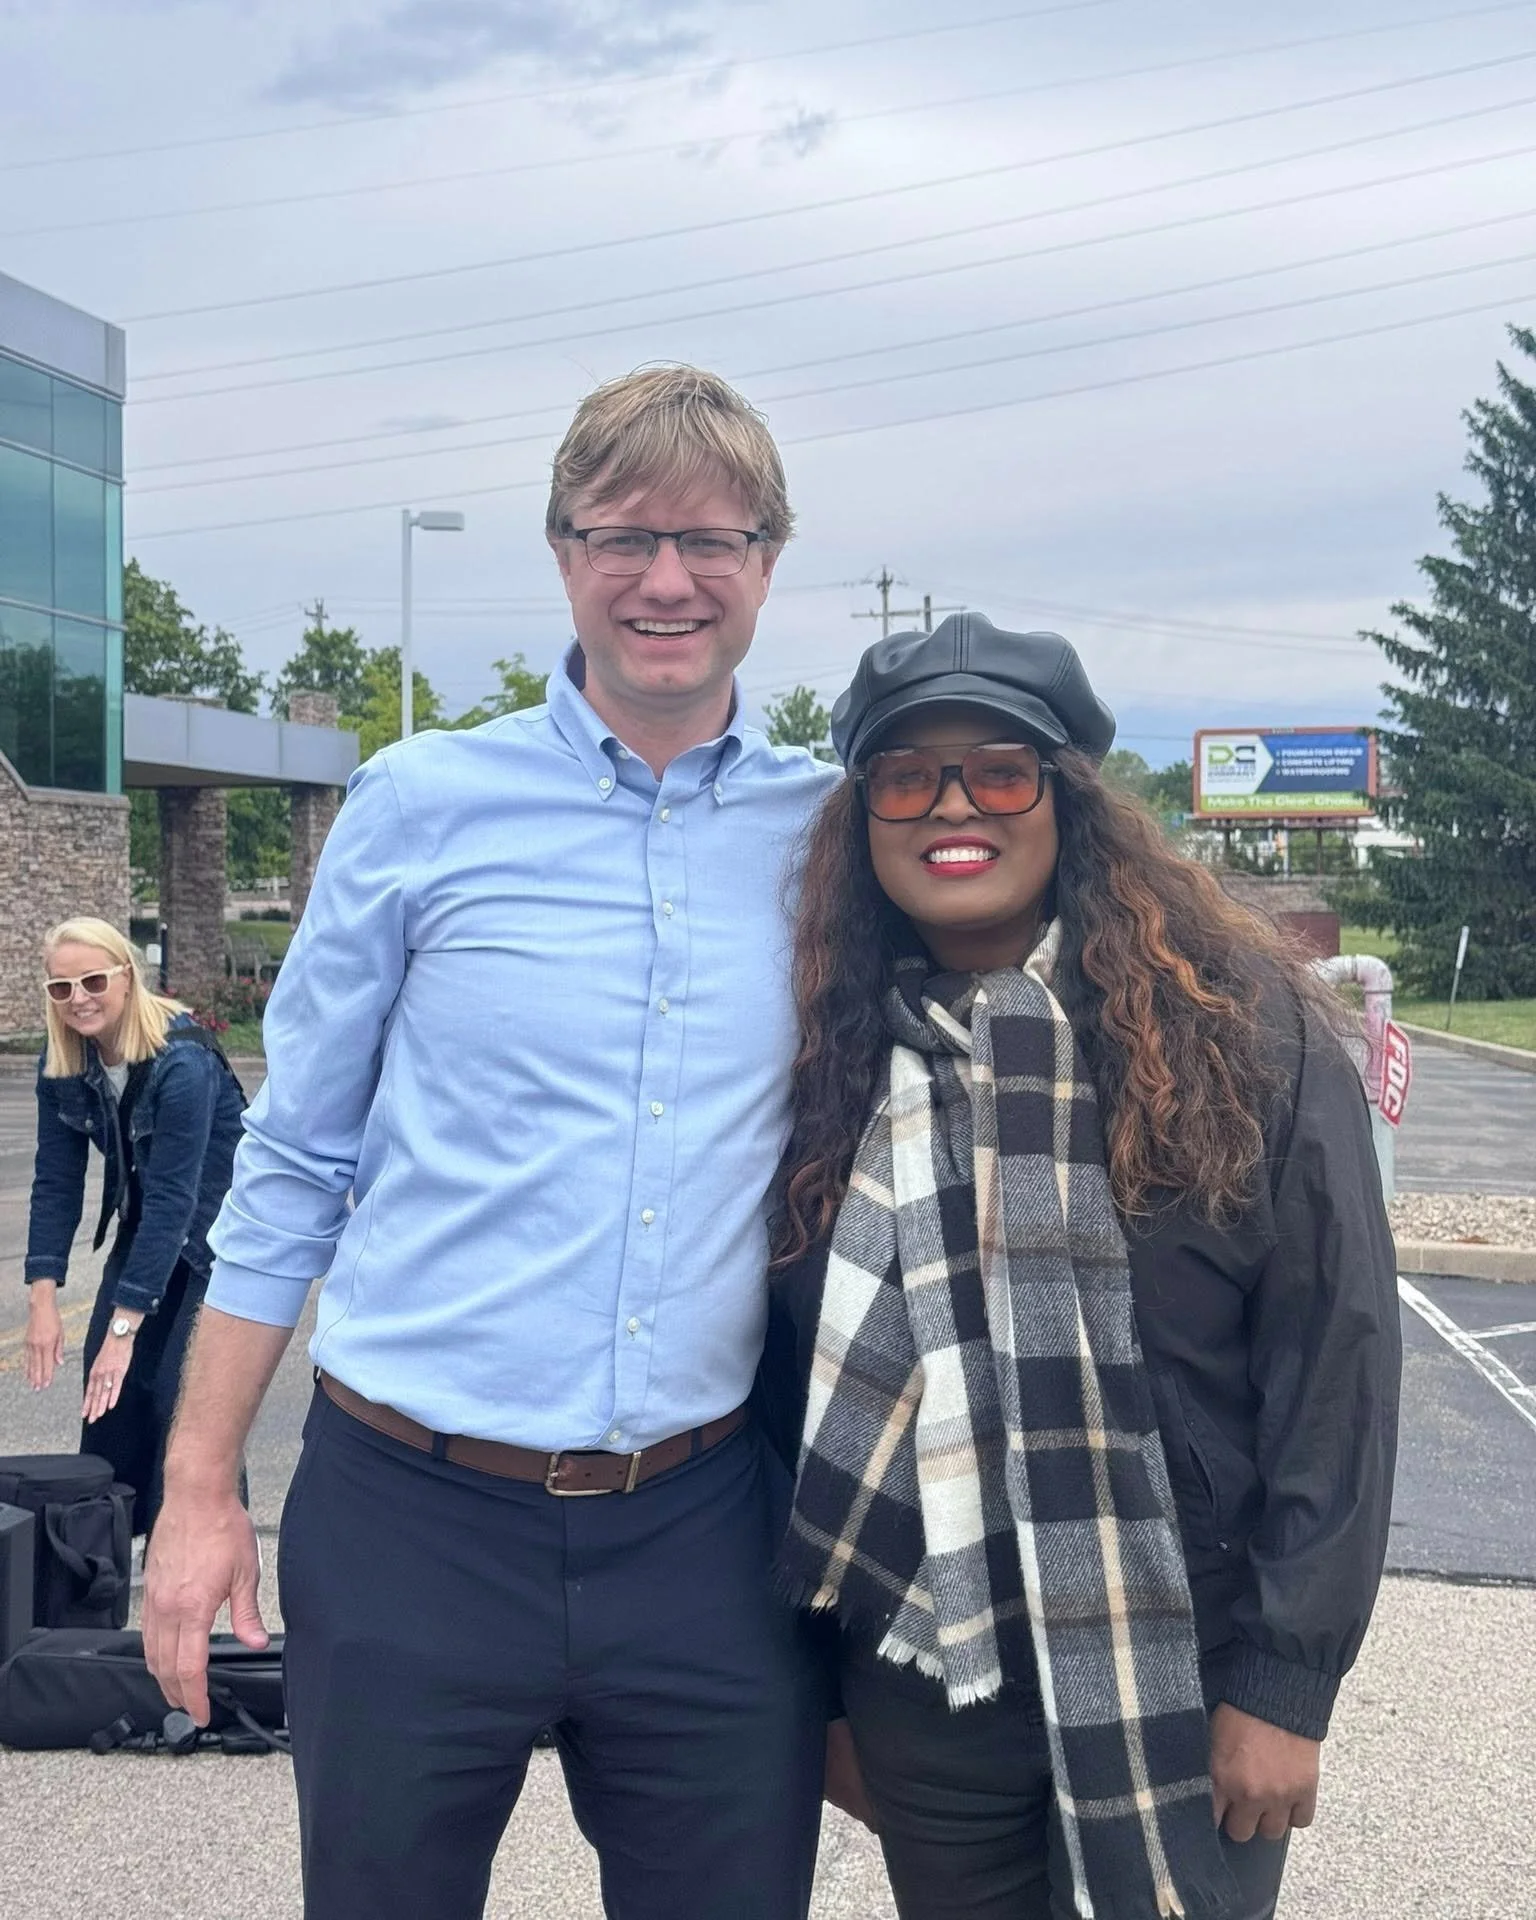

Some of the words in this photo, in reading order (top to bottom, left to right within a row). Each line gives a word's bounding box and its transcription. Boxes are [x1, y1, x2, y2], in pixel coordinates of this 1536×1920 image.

[1207, 796, 1245, 808] Make
[1248, 795, 1273, 807] The
[1275, 794, 1311, 806] Clear
[1384, 1031, 1407, 1117] FDC
